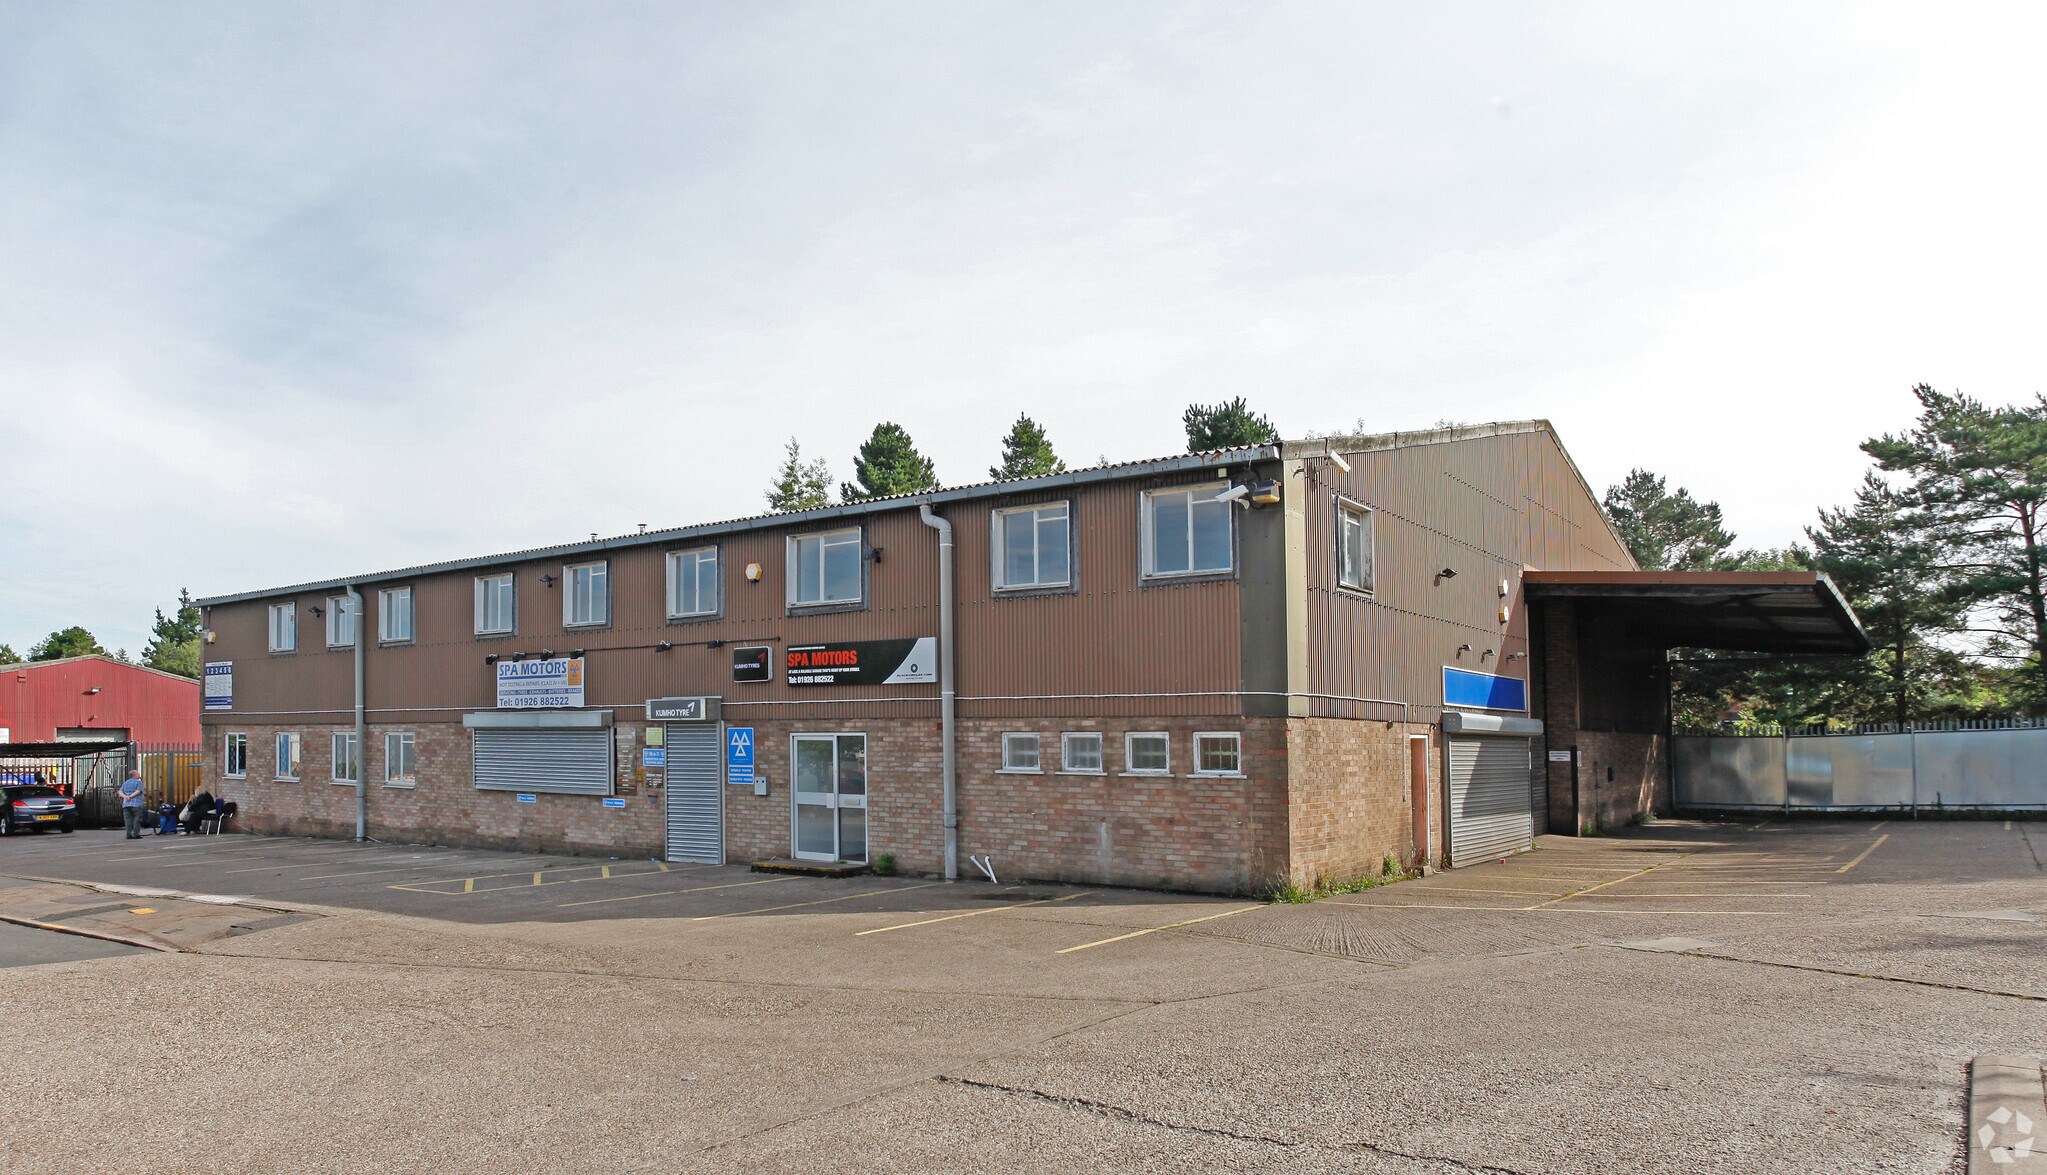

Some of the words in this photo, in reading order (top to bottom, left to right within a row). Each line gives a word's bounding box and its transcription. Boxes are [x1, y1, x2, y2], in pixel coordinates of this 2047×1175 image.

[788, 652, 809, 667] SPA
[812, 650, 858, 665] MOTORS
[499, 664, 518, 676] SPA
[520, 661, 567, 675] MOTORS
[500, 698, 513, 706] Tel:
[514, 697, 538, 706] 01926
[540, 696, 570, 706] 882522
